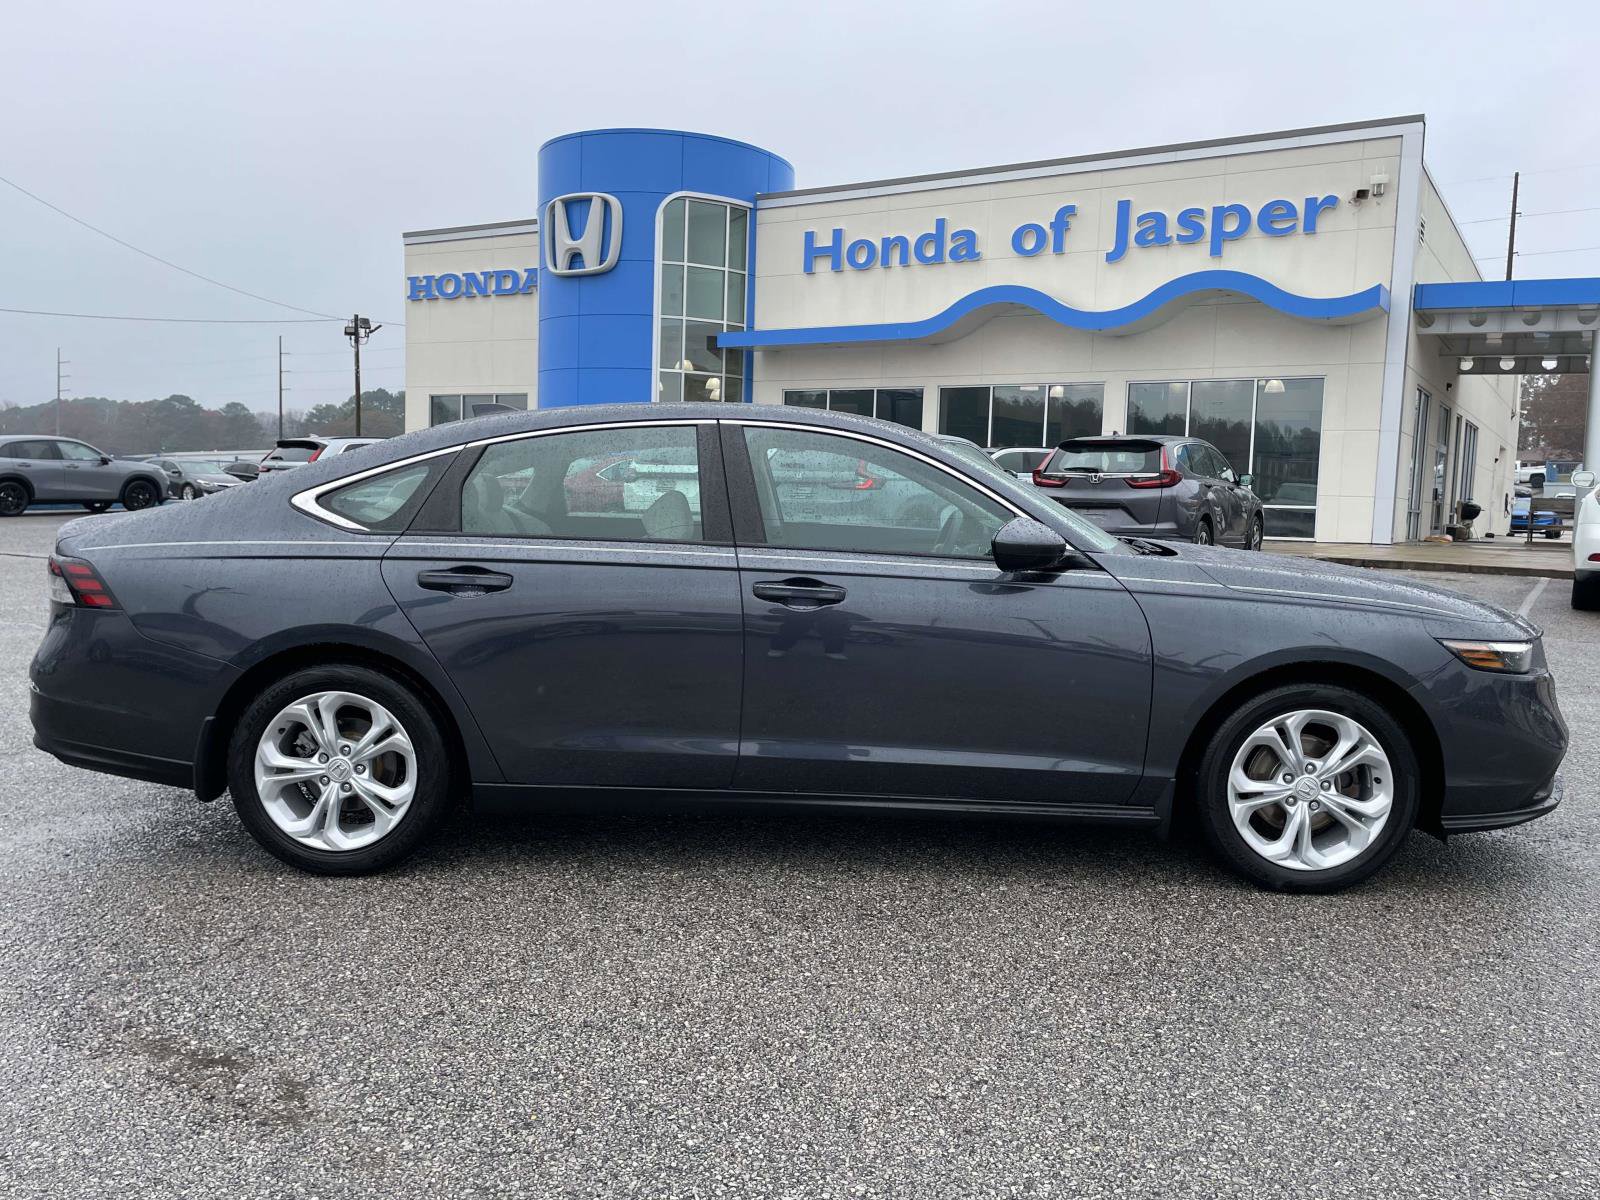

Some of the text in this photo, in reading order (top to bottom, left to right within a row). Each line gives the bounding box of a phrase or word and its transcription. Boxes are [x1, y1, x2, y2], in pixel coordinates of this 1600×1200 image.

[804, 195, 1338, 274] Honda of Jasper
